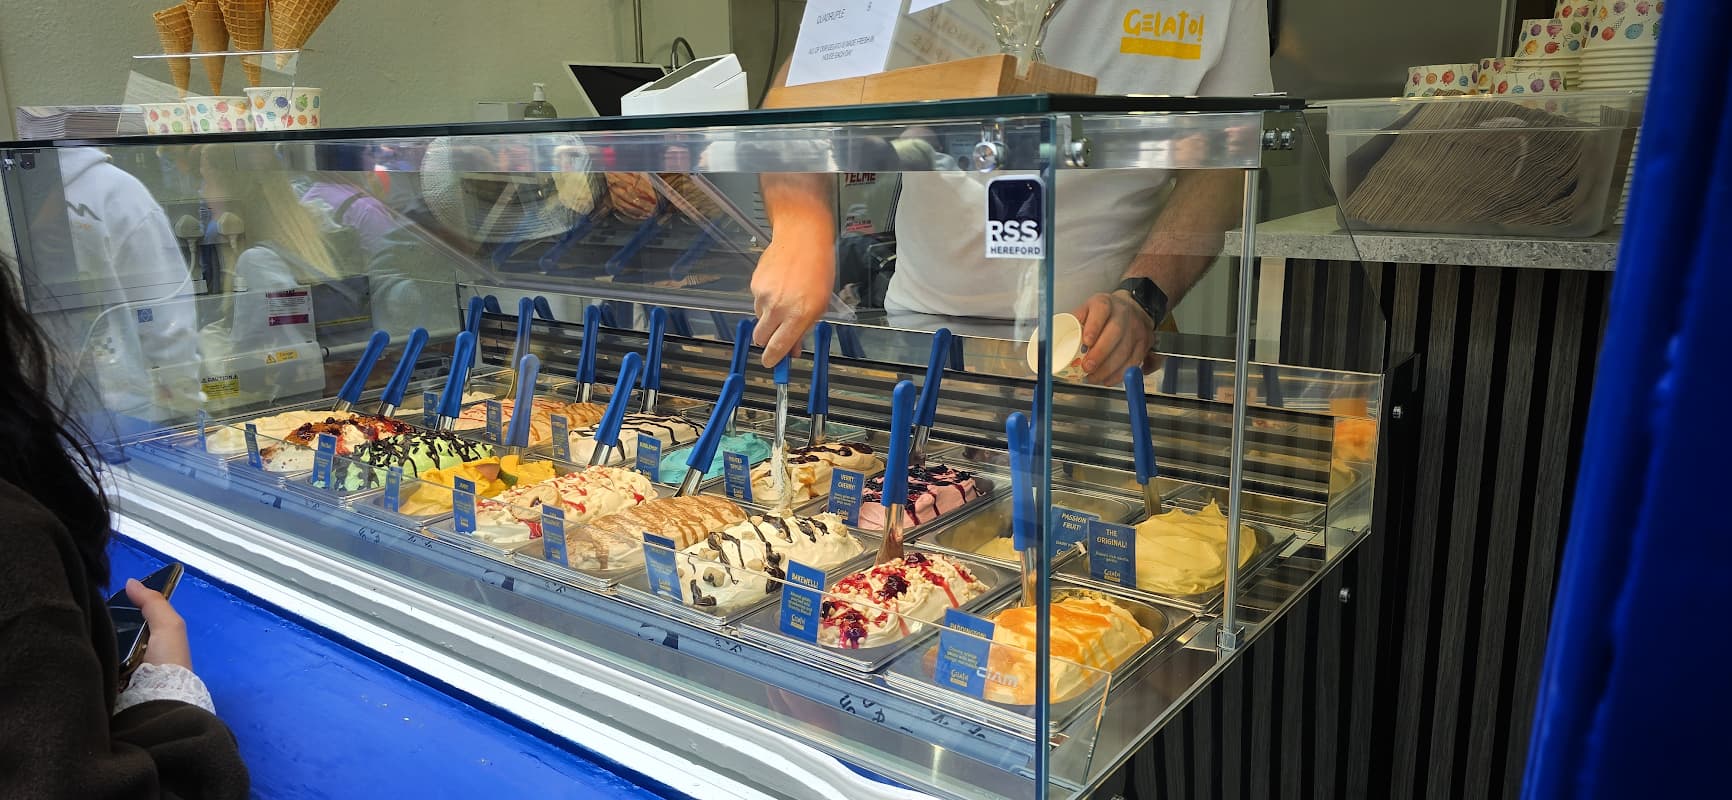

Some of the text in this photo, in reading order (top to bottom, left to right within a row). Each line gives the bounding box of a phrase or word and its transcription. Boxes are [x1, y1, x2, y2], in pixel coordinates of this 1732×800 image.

[1123, 8, 1204, 42] GELATO!
[987, 219, 1038, 242] RSS
[990, 246, 1041, 255] HEREFORD
[1062, 512, 1087, 524] PASSION
[1063, 522, 1082, 531] FRUIT!
[1105, 529, 1118, 537] THE
[1096, 536, 1128, 548] ORIGINAL!
[792, 573, 819, 588] BAKEWELL!
